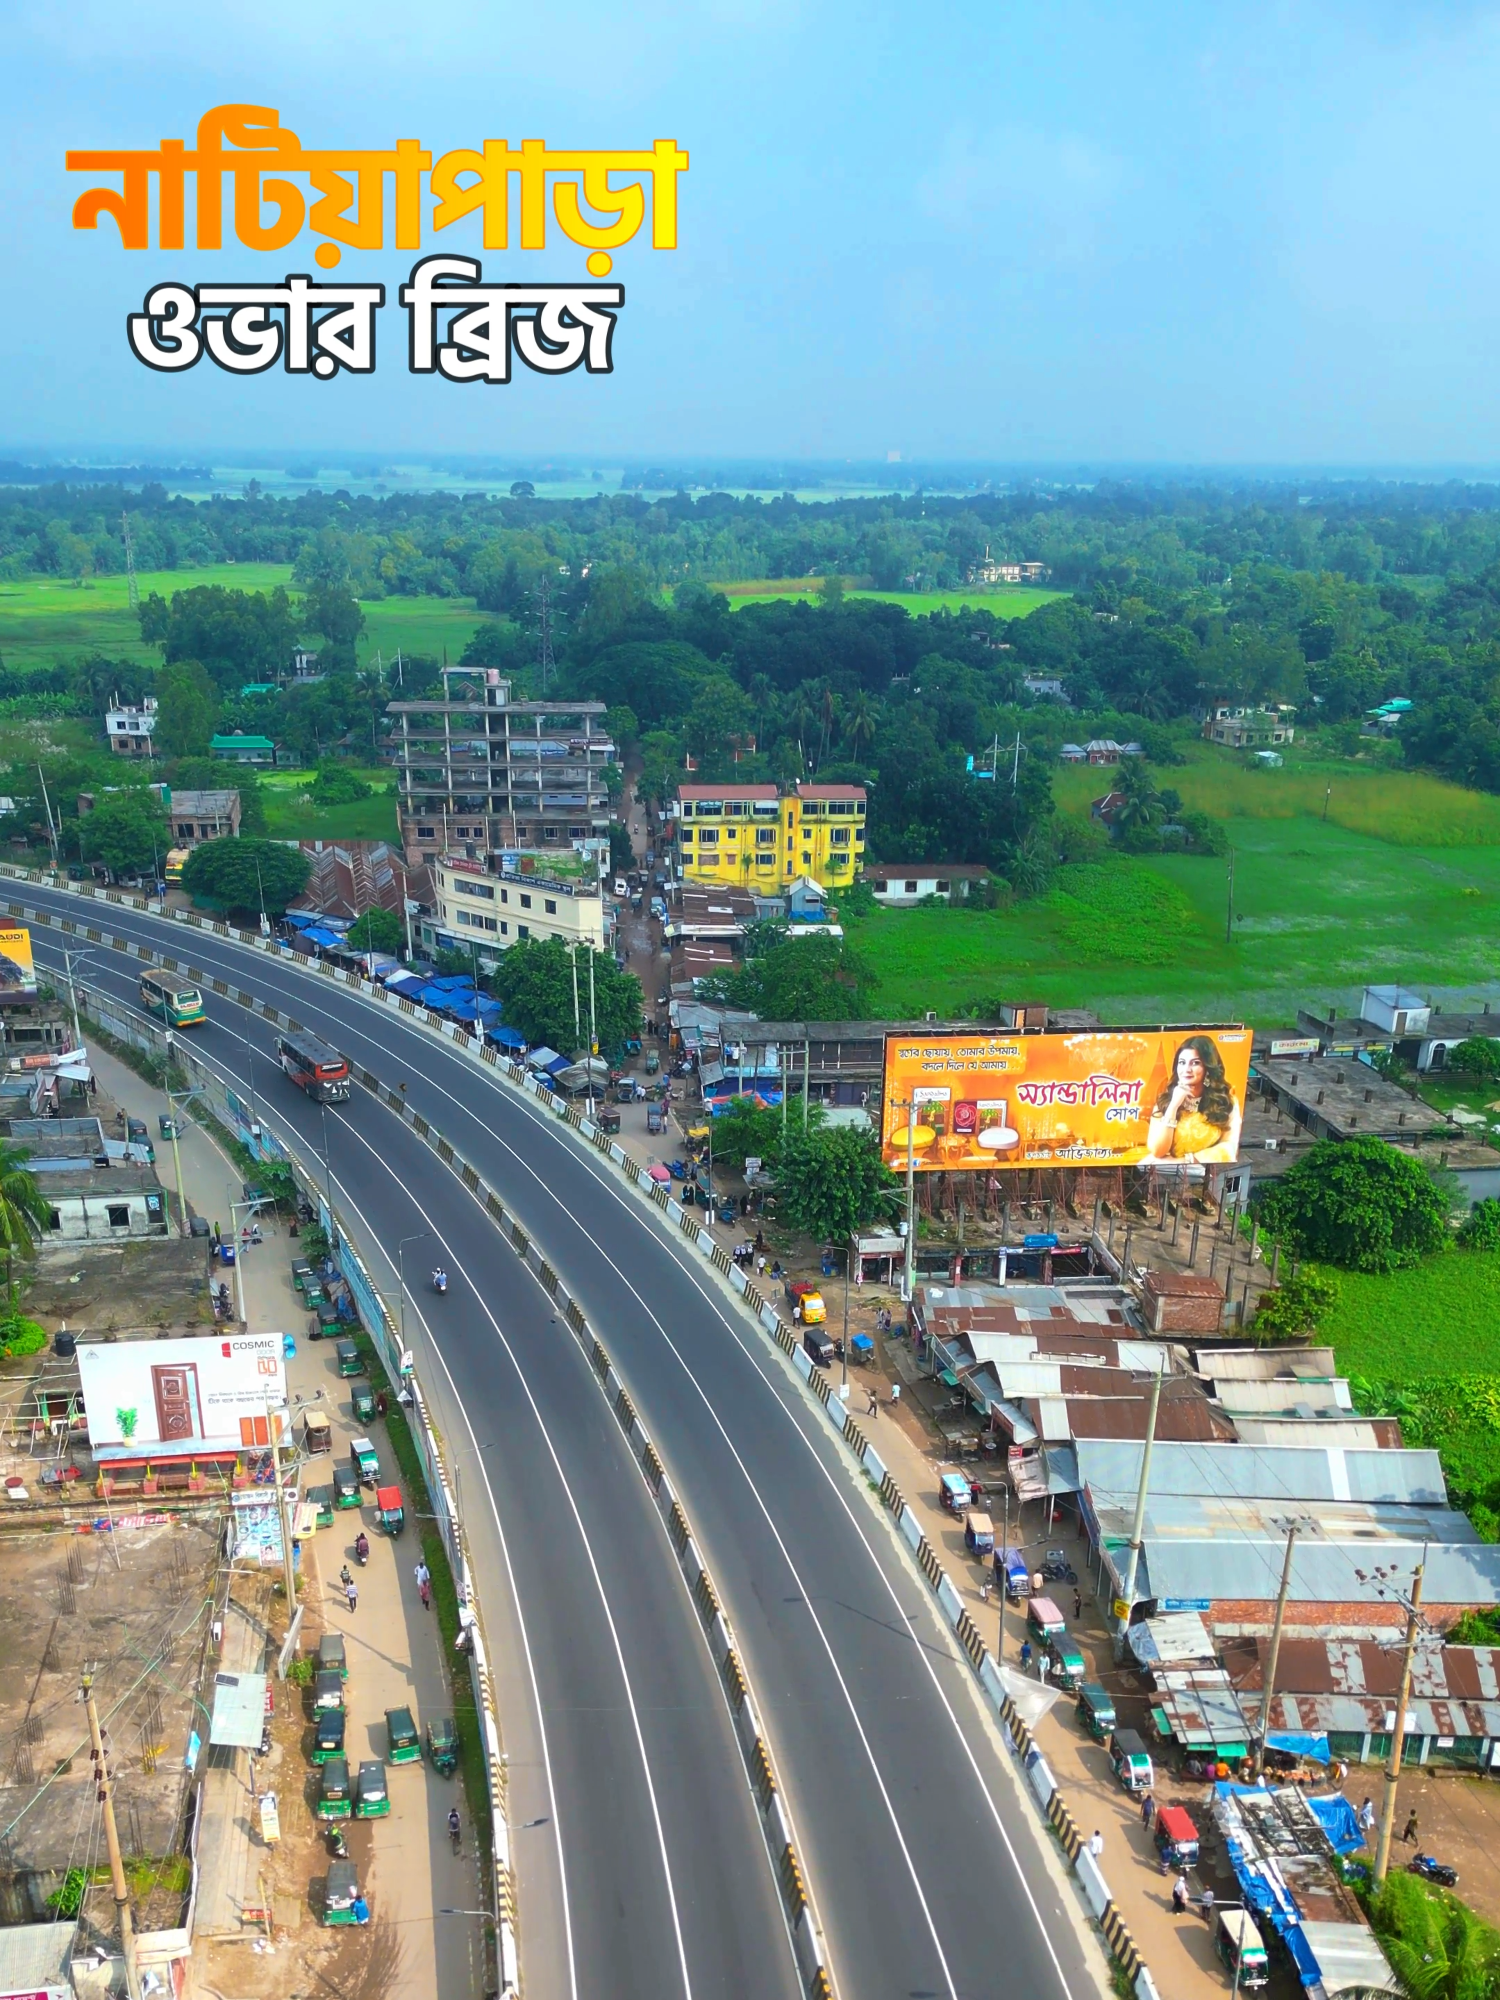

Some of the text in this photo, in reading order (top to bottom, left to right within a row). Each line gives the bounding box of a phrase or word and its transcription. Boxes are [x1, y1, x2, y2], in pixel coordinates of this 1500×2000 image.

[947, 1059, 965, 1070] দিলে
[1106, 1107, 1140, 1121] সোপ
[232, 1340, 275, 1350] COSMIC
